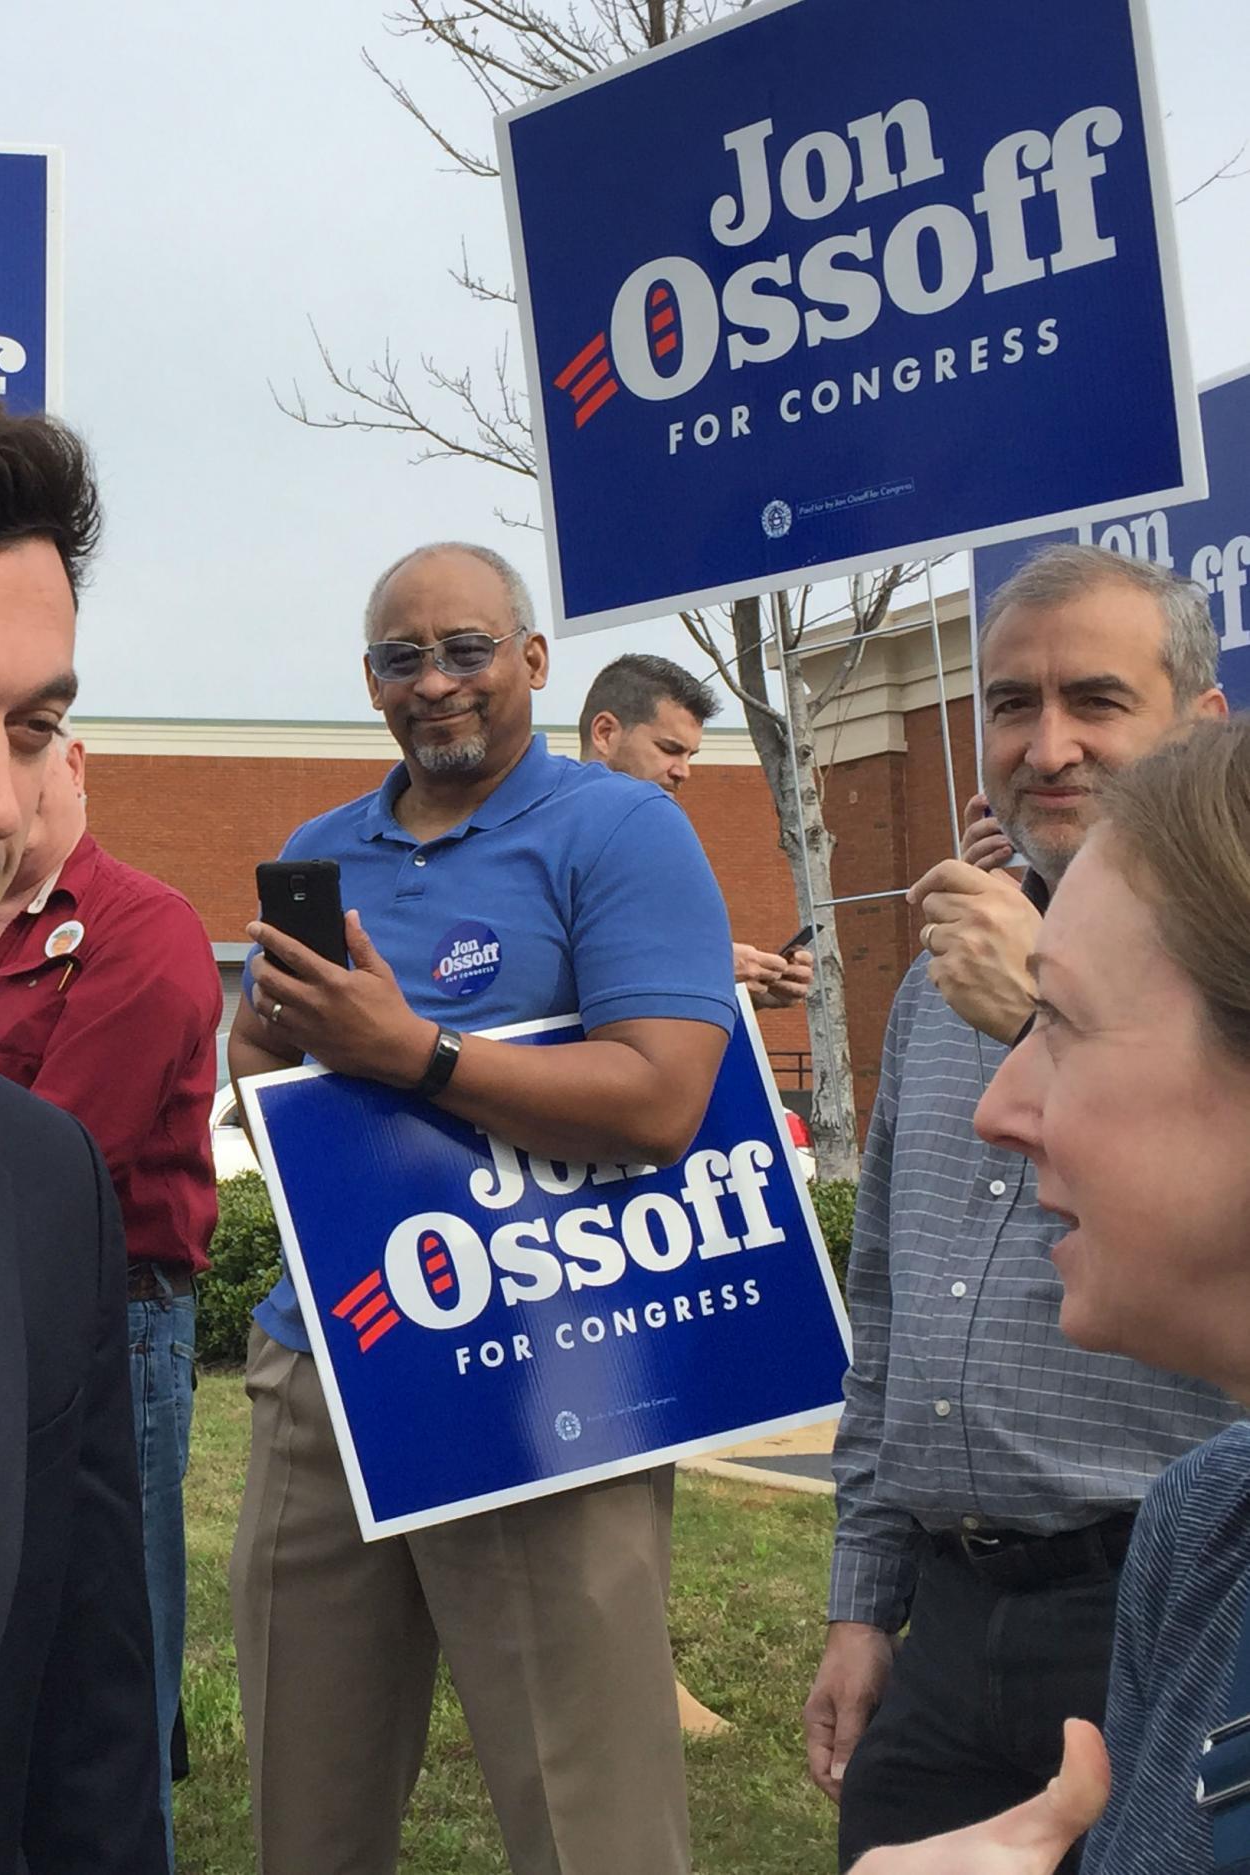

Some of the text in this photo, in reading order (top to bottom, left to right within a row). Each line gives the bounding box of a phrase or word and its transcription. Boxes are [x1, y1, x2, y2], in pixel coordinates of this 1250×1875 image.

[711, 99, 944, 246] Jon
[611, 107, 1122, 400] Ossoff
[670, 319, 1058, 454] FOR CONGRESS
[439, 942, 500, 976] Ossoff
[451, 939, 479, 957] Jon
[385, 1141, 785, 1330] Ossoff
[457, 1280, 760, 1375] FOR CONGRESS
